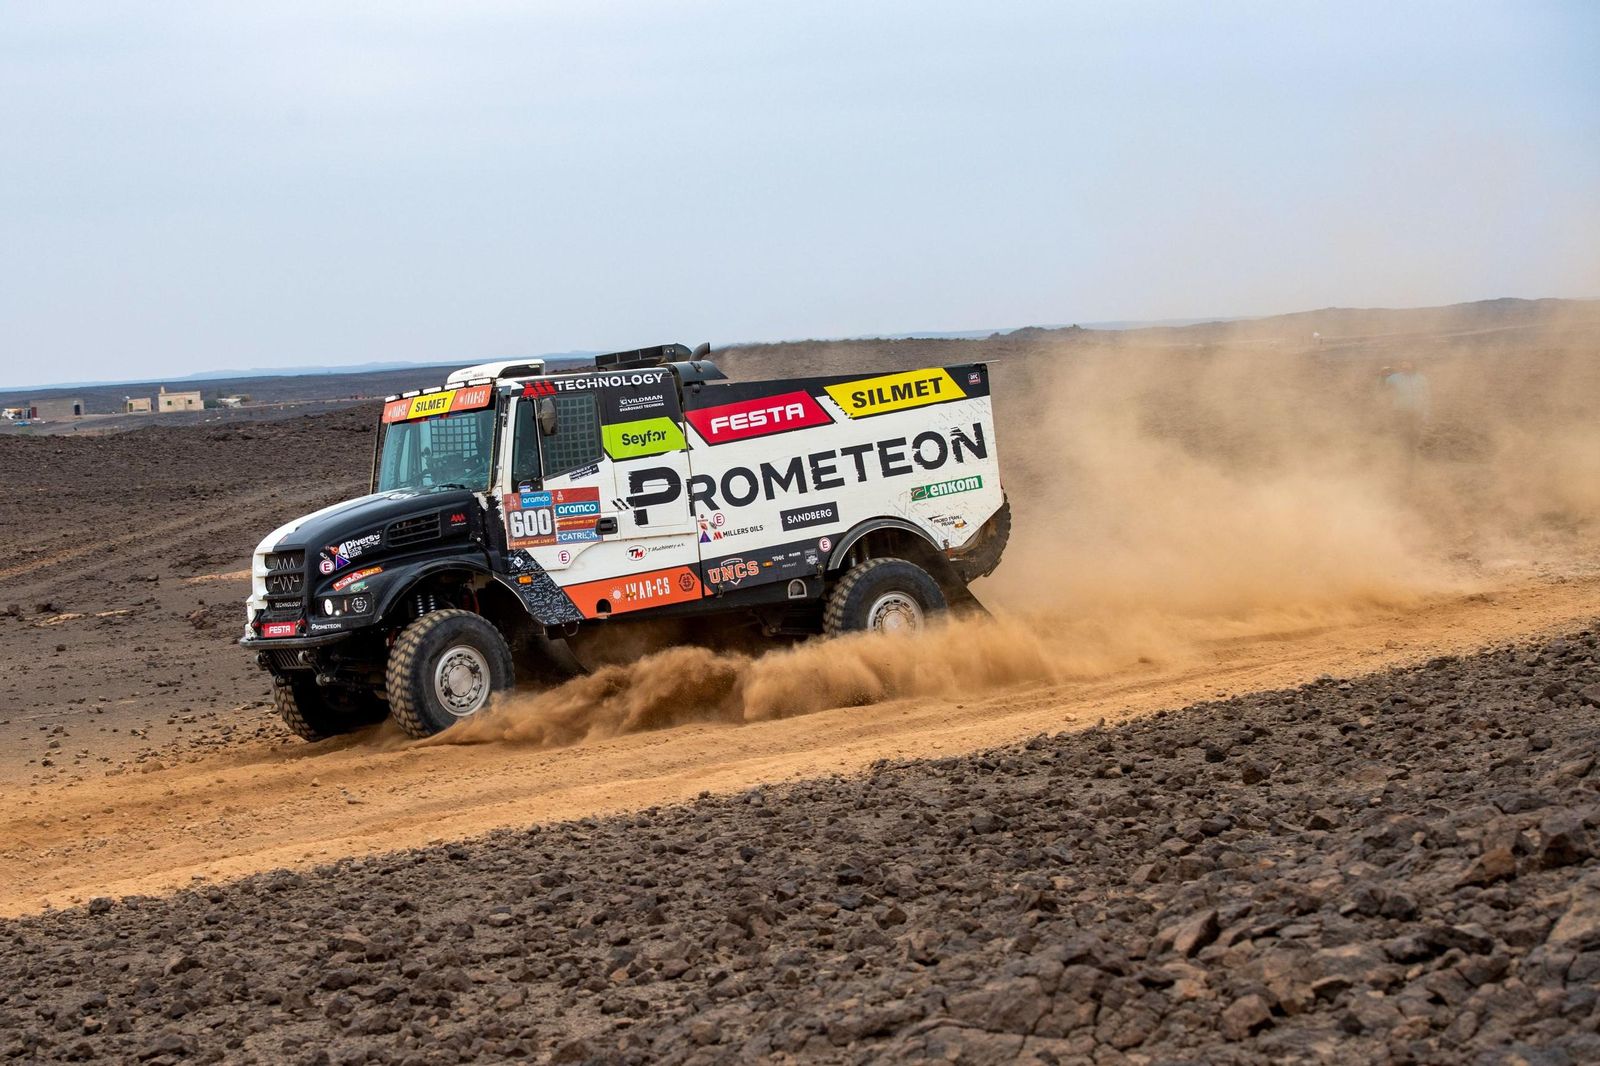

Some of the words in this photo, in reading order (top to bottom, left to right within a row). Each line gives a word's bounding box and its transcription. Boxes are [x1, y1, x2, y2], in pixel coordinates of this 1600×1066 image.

[555, 373, 663, 391] TECHNOLOGY
[627, 394, 663, 404] VILDMAN
[851, 377, 943, 409] SILMET
[415, 397, 447, 413] SILMET
[710, 402, 805, 435] FESTA
[621, 430, 667, 447] Seyfor
[626, 422, 988, 527] PROMETEON
[929, 477, 979, 497] enkom
[522, 495, 550, 504] aramco
[558, 503, 597, 514] aramco
[786, 508, 833, 525] SANDBERG
[509, 508, 553, 538] 600
[722, 527, 749, 538] MILLERS
[749, 524, 764, 533] OILS
[629, 548, 644, 559] TM
[707, 560, 760, 585] UNCS
[268, 625, 291, 634] FESTA
